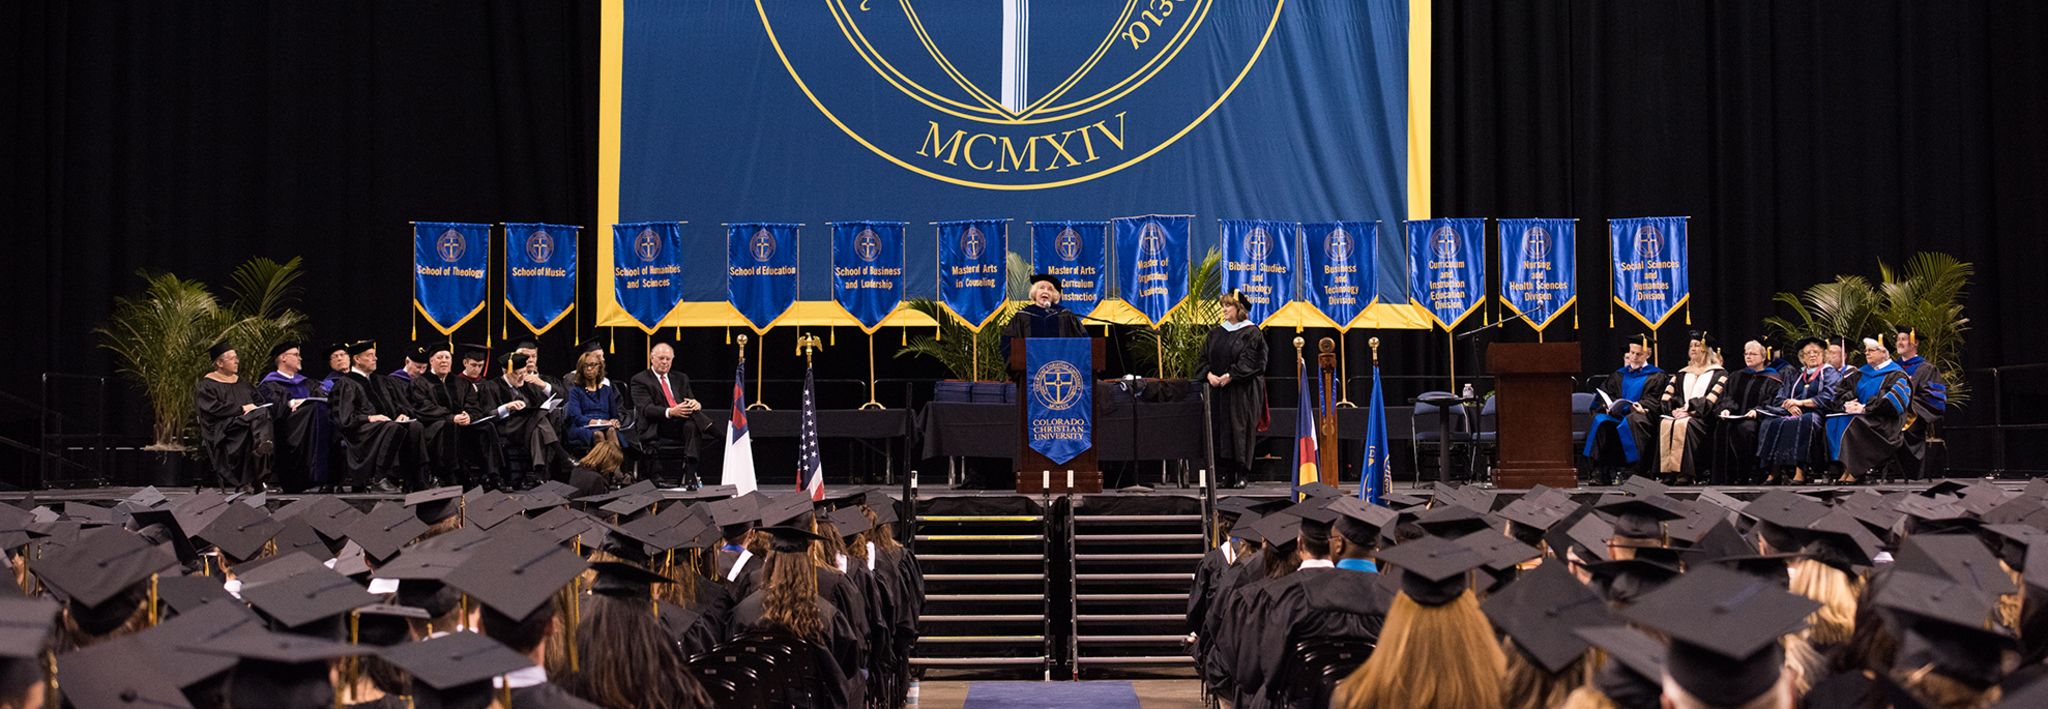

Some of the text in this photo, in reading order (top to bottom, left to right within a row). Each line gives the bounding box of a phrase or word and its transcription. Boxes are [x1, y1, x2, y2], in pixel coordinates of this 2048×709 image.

[916, 111, 1129, 173] MCMXIV
[1138, 256, 1169, 269] Master of
[1228, 261, 1287, 274] Biblical Studies
[1429, 260, 1465, 269] Curriculum
[1523, 260, 1551, 271] Nursing
[1621, 260, 1679, 271] Social Sciences
[417, 265, 485, 279] School of Theology
[512, 266, 566, 277] School of Music
[615, 266, 640, 276] School
[649, 263, 681, 274] Humanities
[729, 266, 755, 276] School
[762, 265, 796, 275] Education
[835, 266, 861, 277] School
[869, 265, 901, 276] Business
[982, 264, 998, 273] Arts
[1048, 265, 1073, 275] Master
[1080, 265, 1096, 275] Arts
[1324, 264, 1357, 274] Business
[1252, 273, 1263, 283] and
[1334, 274, 1347, 283] and
[1440, 270, 1453, 279] and
[1531, 270, 1544, 280] and
[1644, 270, 1658, 280] and
[627, 279, 640, 289] and
[845, 279, 858, 289] and
[955, 279, 964, 289] in
[1061, 278, 1094, 288] Curriculum
[1429, 280, 1465, 290] Instruction
[1509, 280, 1568, 291] Health Sciences
[1633, 281, 1669, 291] Humanities
[1061, 289, 1098, 301] Instruction
[1323, 285, 1359, 295] Technology
[1328, 294, 1356, 305] Division
[1430, 291, 1466, 301] Education
[1524, 291, 1552, 301] Division
[1637, 291, 1665, 301] Division
[1434, 301, 1462, 310] Division
[1032, 418, 1085, 427] COLORADO
[1033, 425, 1084, 434] CHRISTIAN
[1034, 432, 1084, 440] UNIVERSITY
